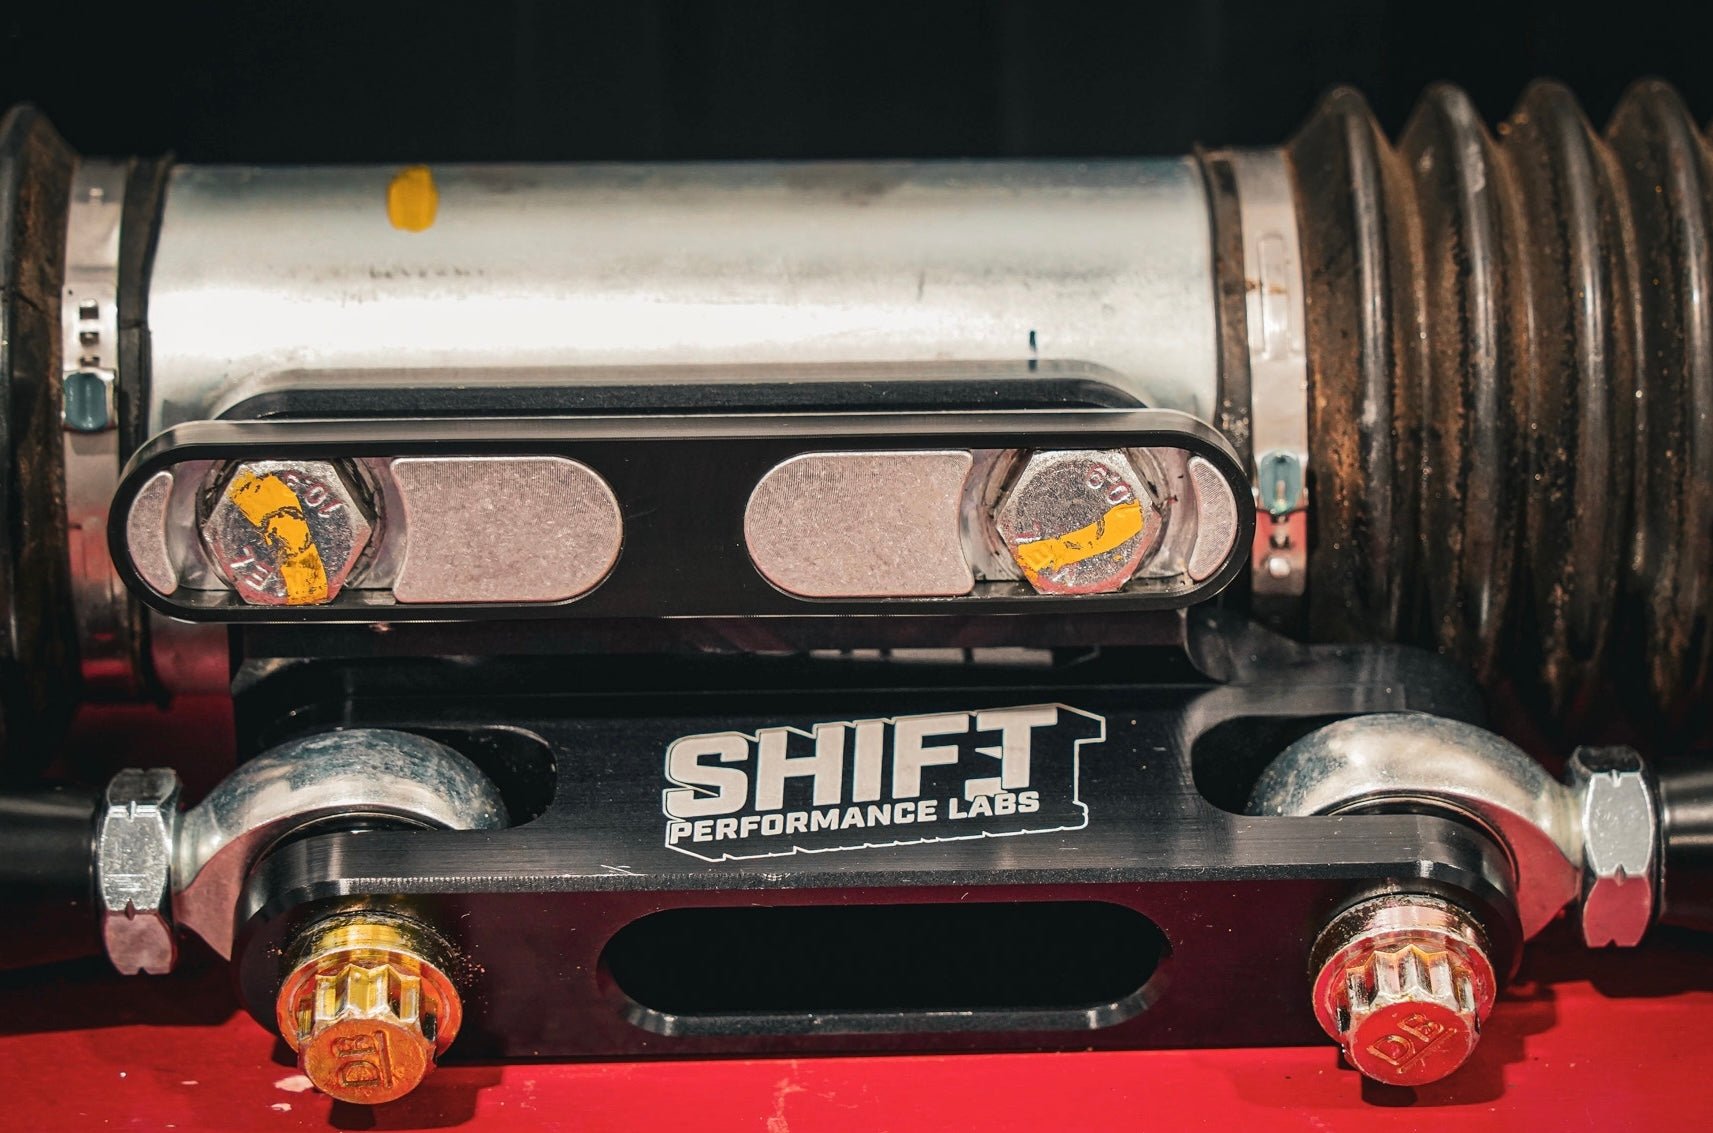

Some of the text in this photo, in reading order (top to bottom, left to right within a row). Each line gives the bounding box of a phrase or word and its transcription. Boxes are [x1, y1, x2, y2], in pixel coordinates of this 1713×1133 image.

[666, 706, 1058, 818] SHIFT
[669, 790, 1041, 845] PERFORMANCE LABS
[331, 1034, 381, 1088] DB
[1366, 1013, 1445, 1066] DB
